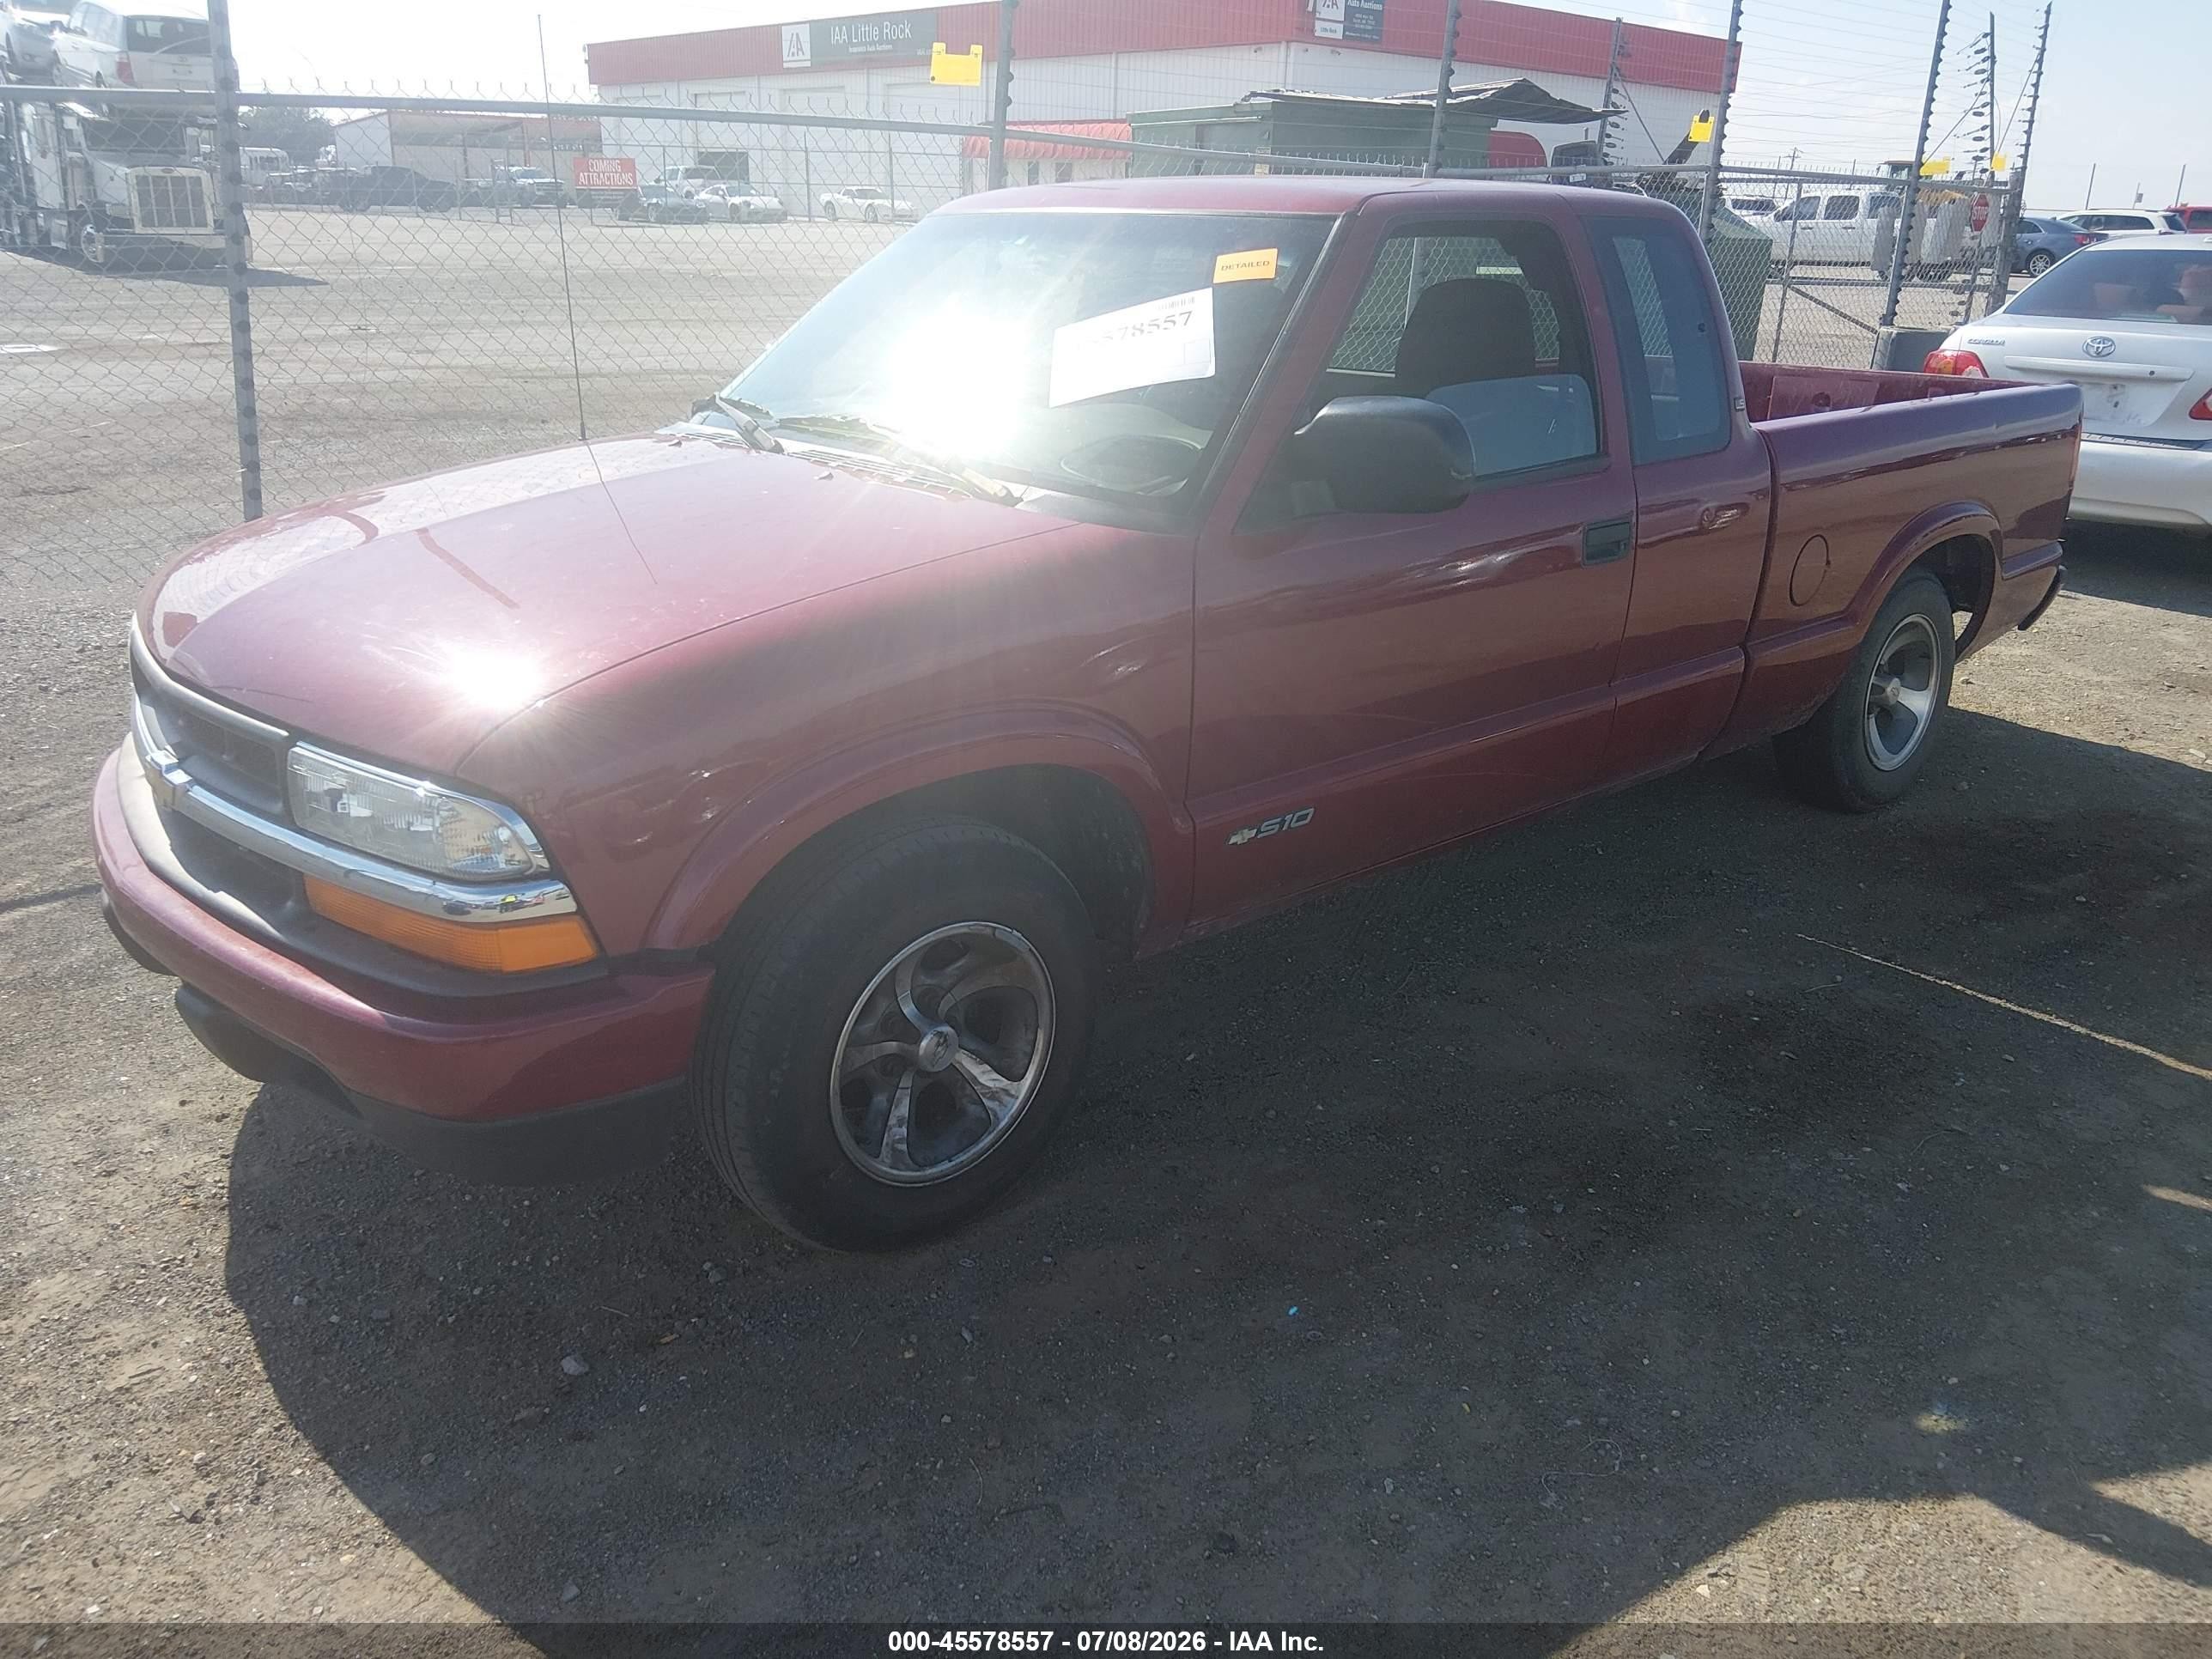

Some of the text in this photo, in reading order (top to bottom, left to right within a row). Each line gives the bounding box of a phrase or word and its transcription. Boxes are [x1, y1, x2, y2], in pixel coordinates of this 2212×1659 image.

[830, 20, 912, 45] IAA Little Rock
[588, 158, 622, 173] COMING
[578, 172, 634, 186] ATTRACTIONS
[1972, 205, 1989, 221] STOP
[1220, 259, 1270, 271] DETAILED
[1256, 807, 1315, 839] S10
